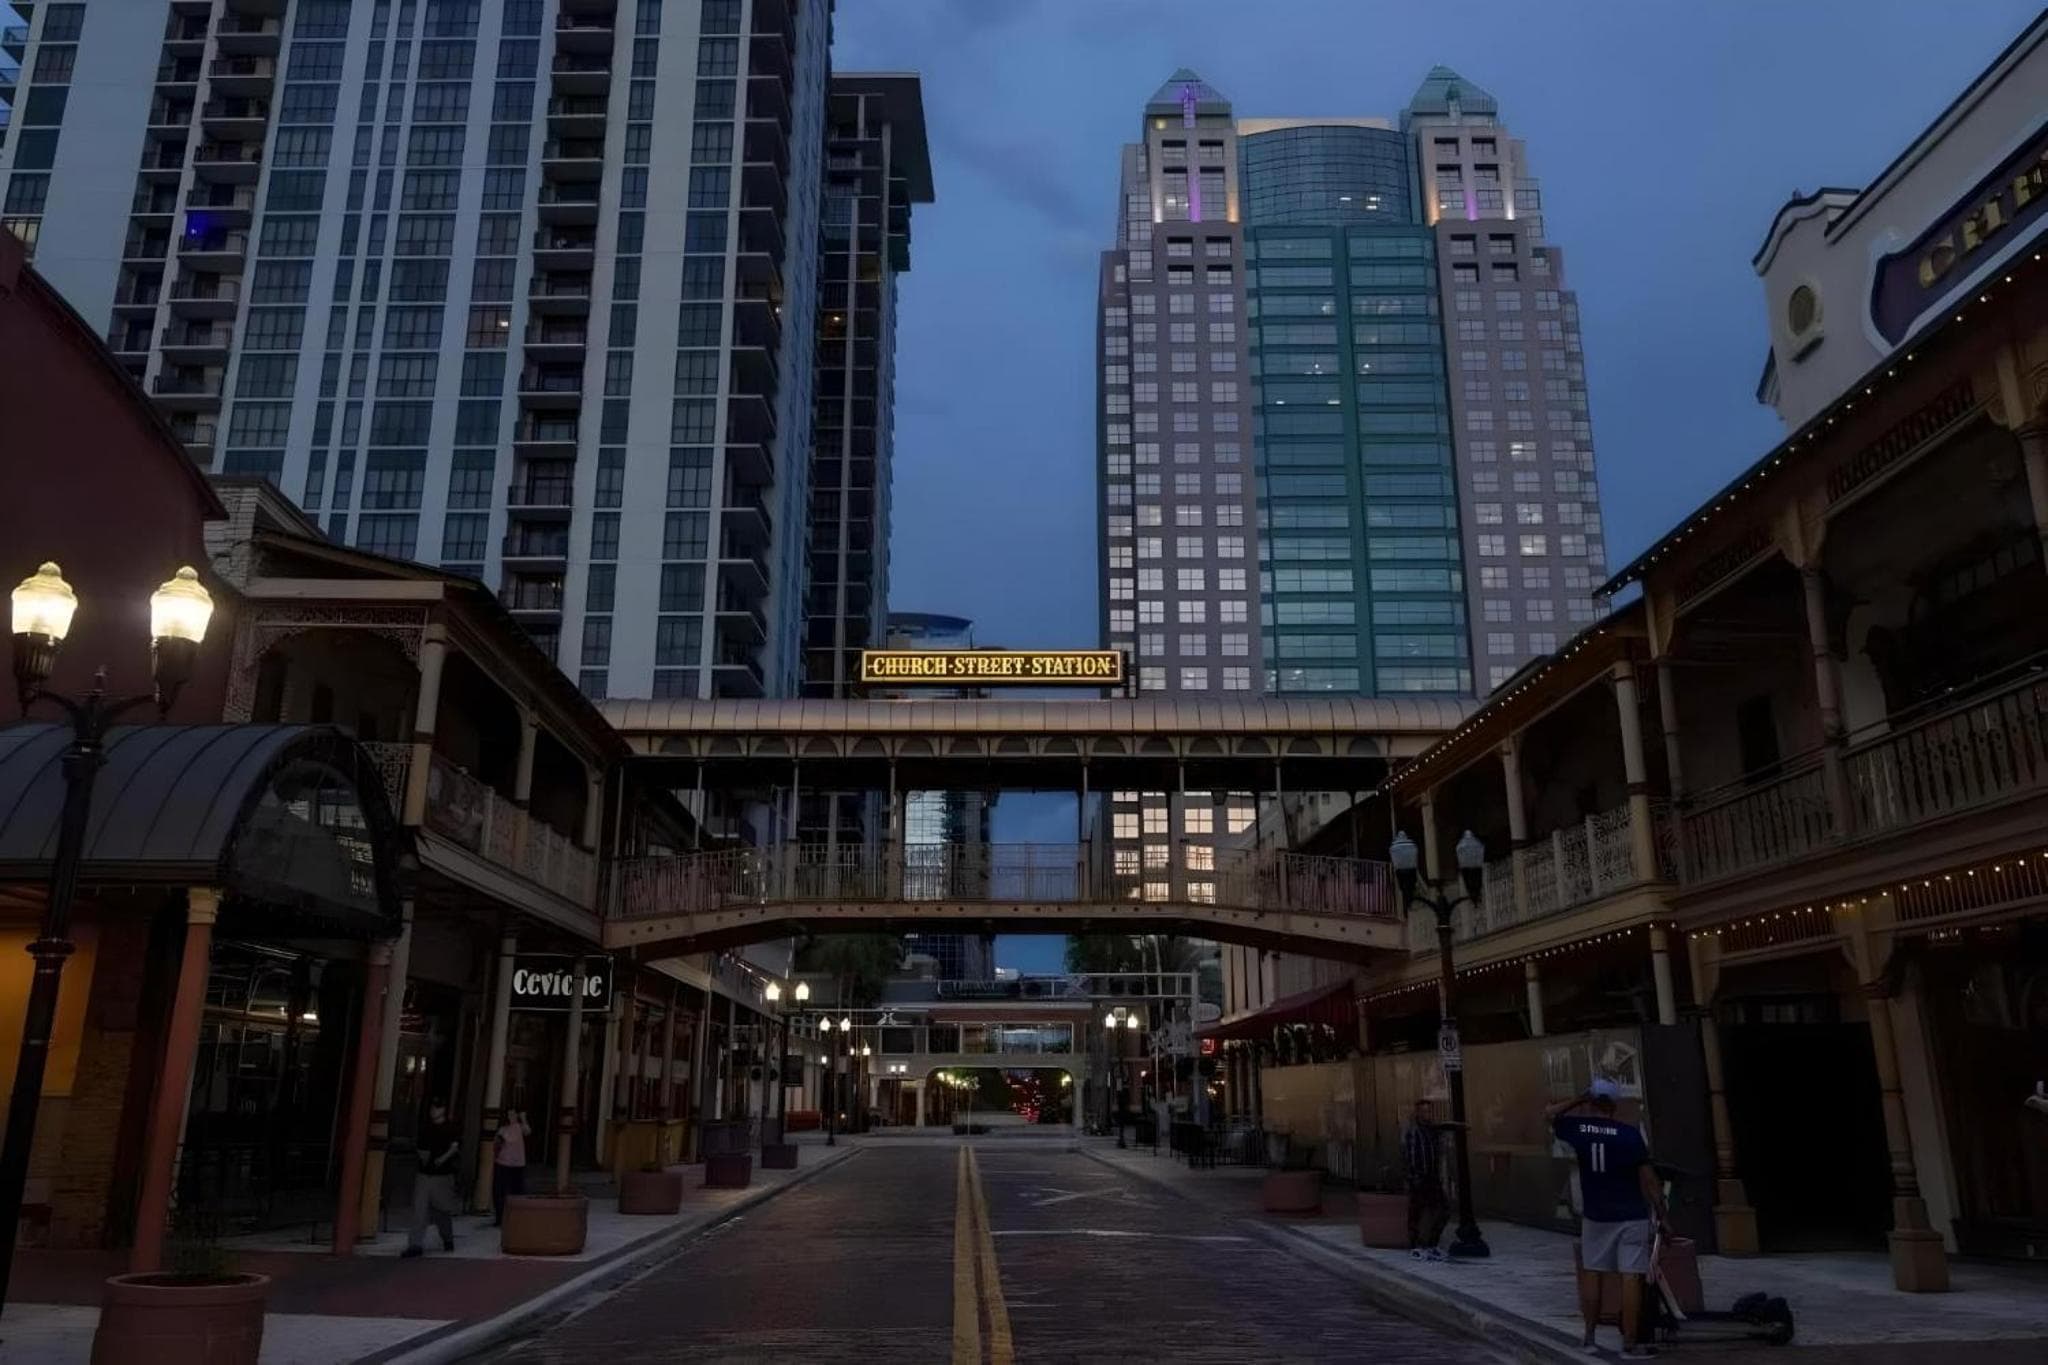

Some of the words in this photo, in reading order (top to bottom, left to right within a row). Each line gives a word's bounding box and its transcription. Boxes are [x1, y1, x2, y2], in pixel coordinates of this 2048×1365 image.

[873, 656, 948, 676] CHURCH
[953, 656, 1025, 676] STREET
[1031, 656, 1112, 676] STATION
[1590, 1141, 1607, 1174] 11
